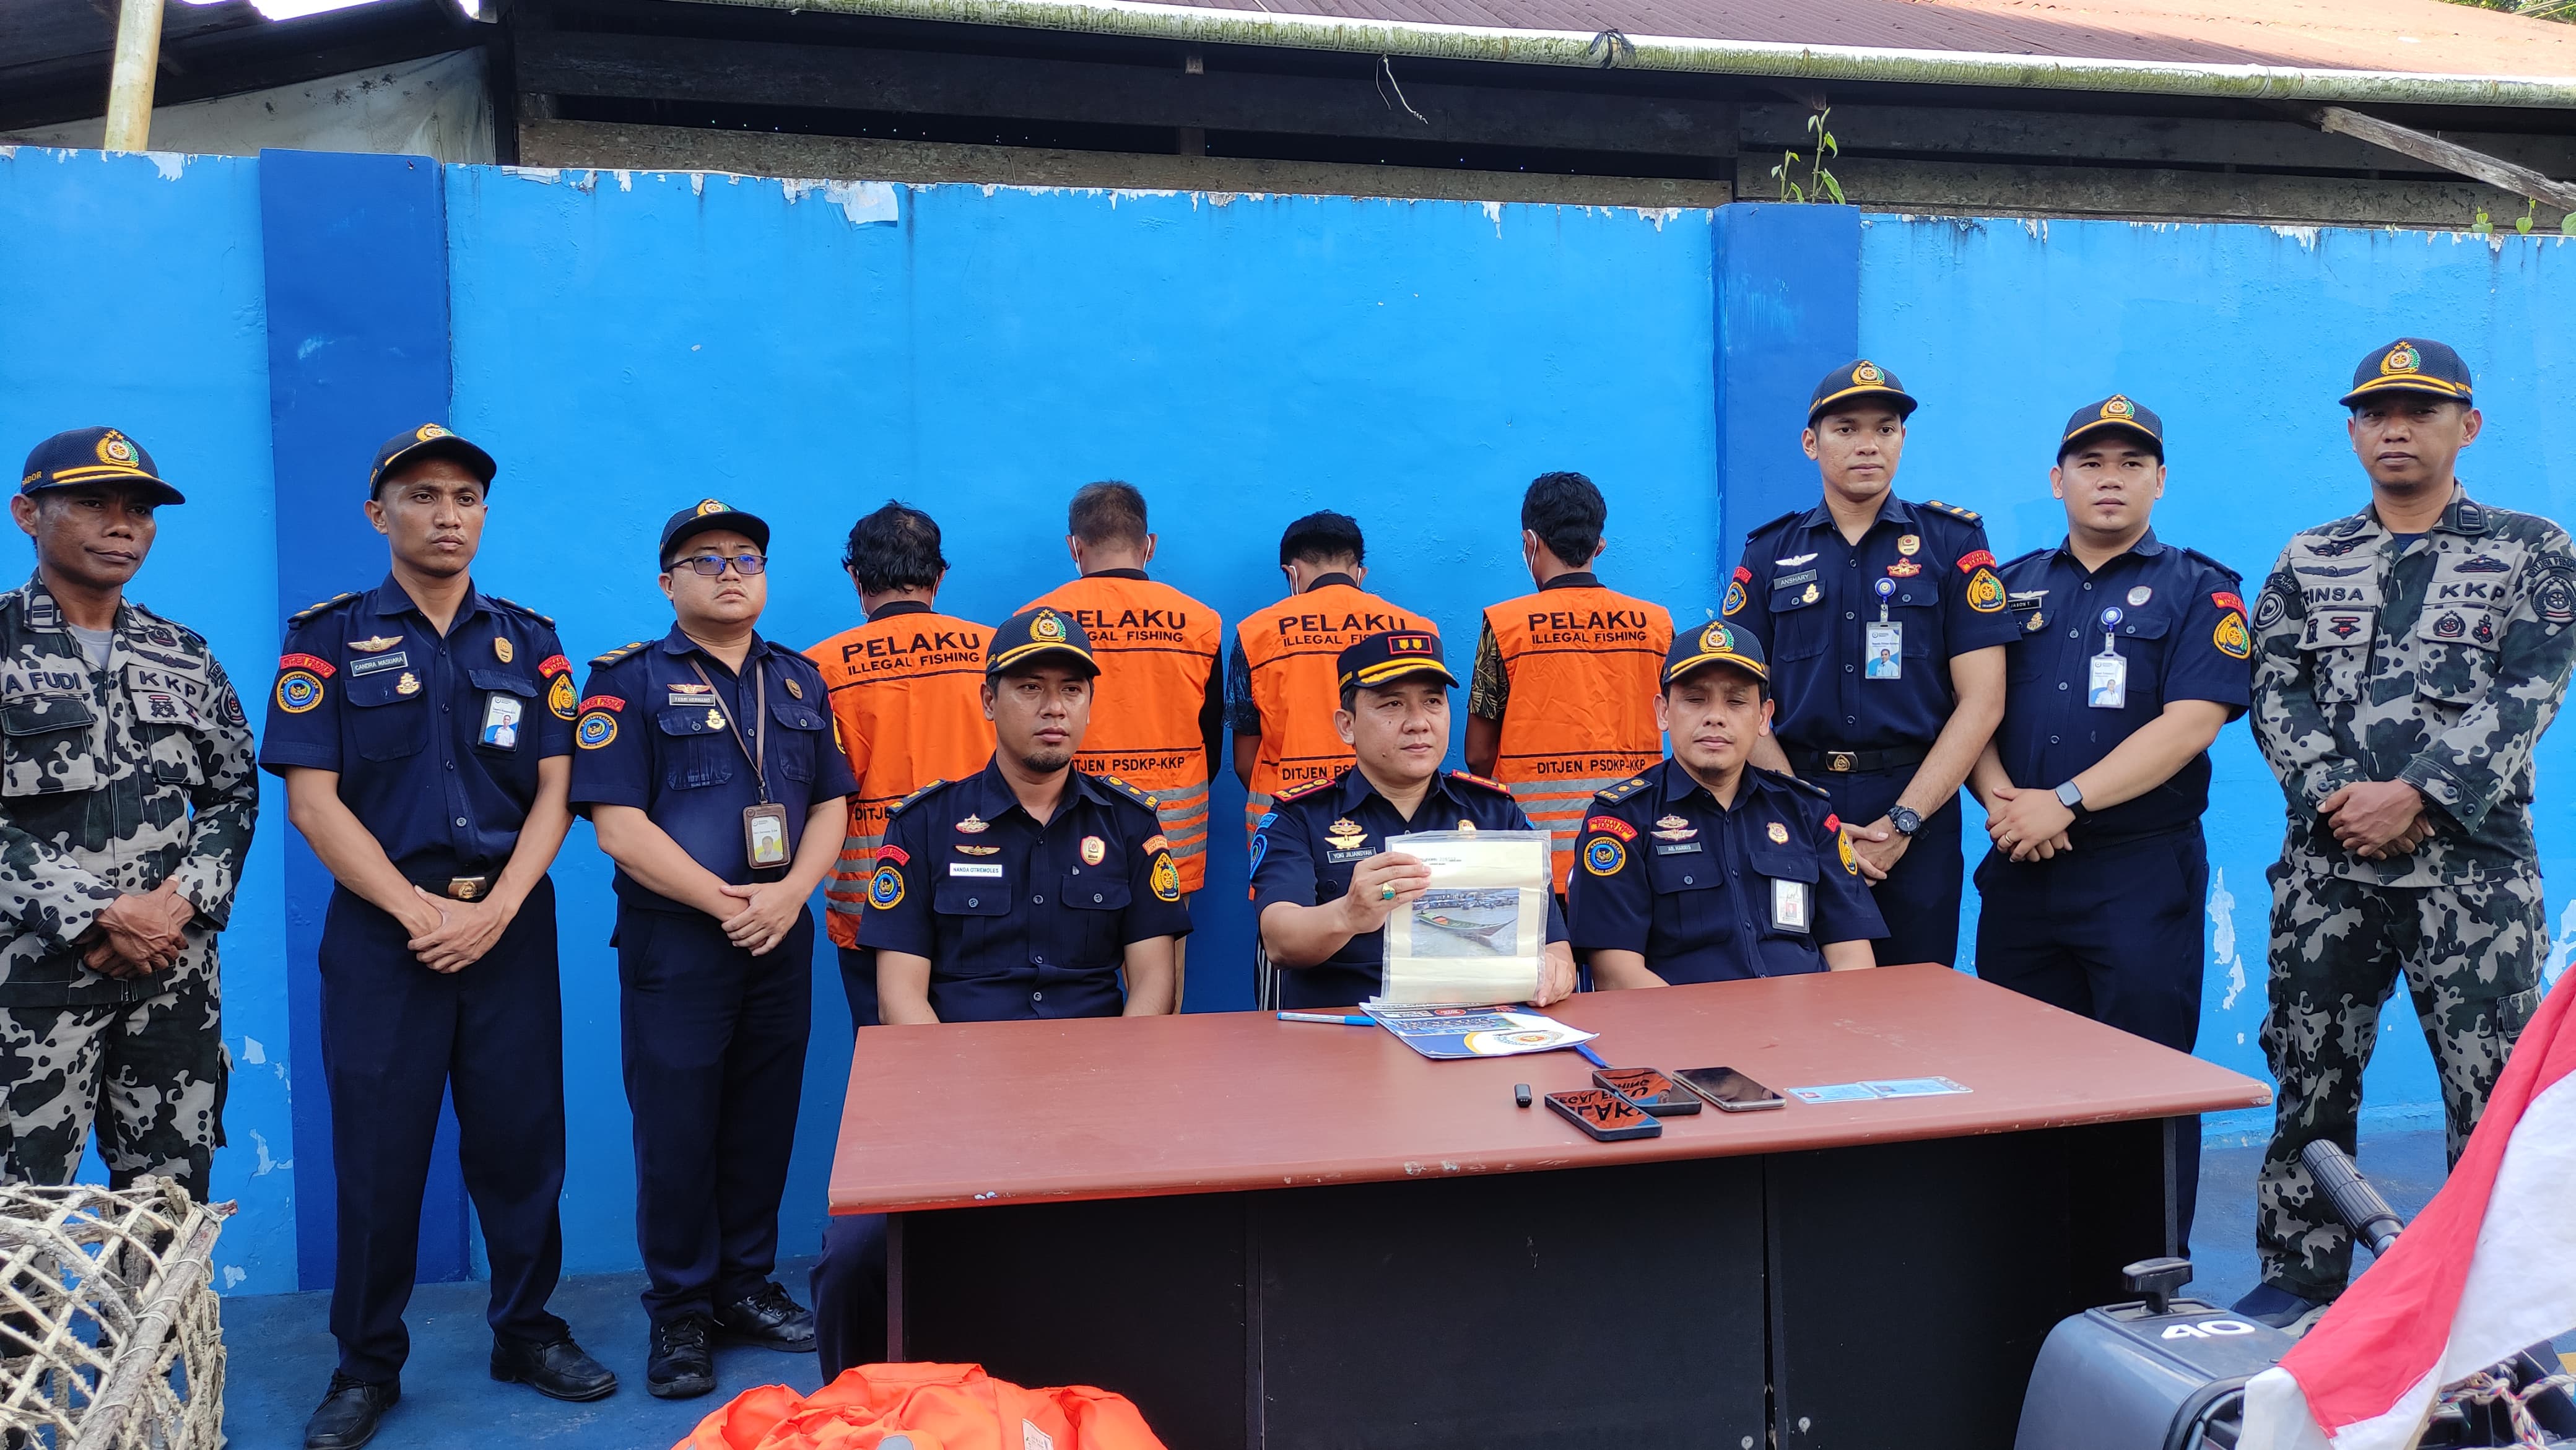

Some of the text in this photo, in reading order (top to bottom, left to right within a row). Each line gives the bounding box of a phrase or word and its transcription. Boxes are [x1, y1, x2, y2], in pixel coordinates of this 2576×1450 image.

[1781, 573, 1810, 585] ANSHARY
[2304, 586, 2364, 606] FINSA
[2439, 583, 2505, 601] KKP
[1279, 614, 1406, 635] PELAKU
[1528, 610, 1647, 631] PELAKU
[1127, 630, 1183, 642] FISHING
[1283, 635, 1342, 647] ILLEGAL
[1532, 631, 1647, 644] ILLEGAL FISHING
[842, 632, 980, 663] PELAKU
[355, 661, 376, 671] CANDRA
[848, 657, 912, 675] ILLEGAL
[920, 652, 980, 666] FISHING
[32, 672, 82, 690] FUDI
[139, 671, 197, 697] KKP
[1113, 757, 1185, 771] PSDKP-KKP
[1282, 765, 1328, 780] DITJEN
[1537, 759, 1646, 774] DITJEN PSDKP-KKP
[2160, 1319, 2256, 1339] 40
